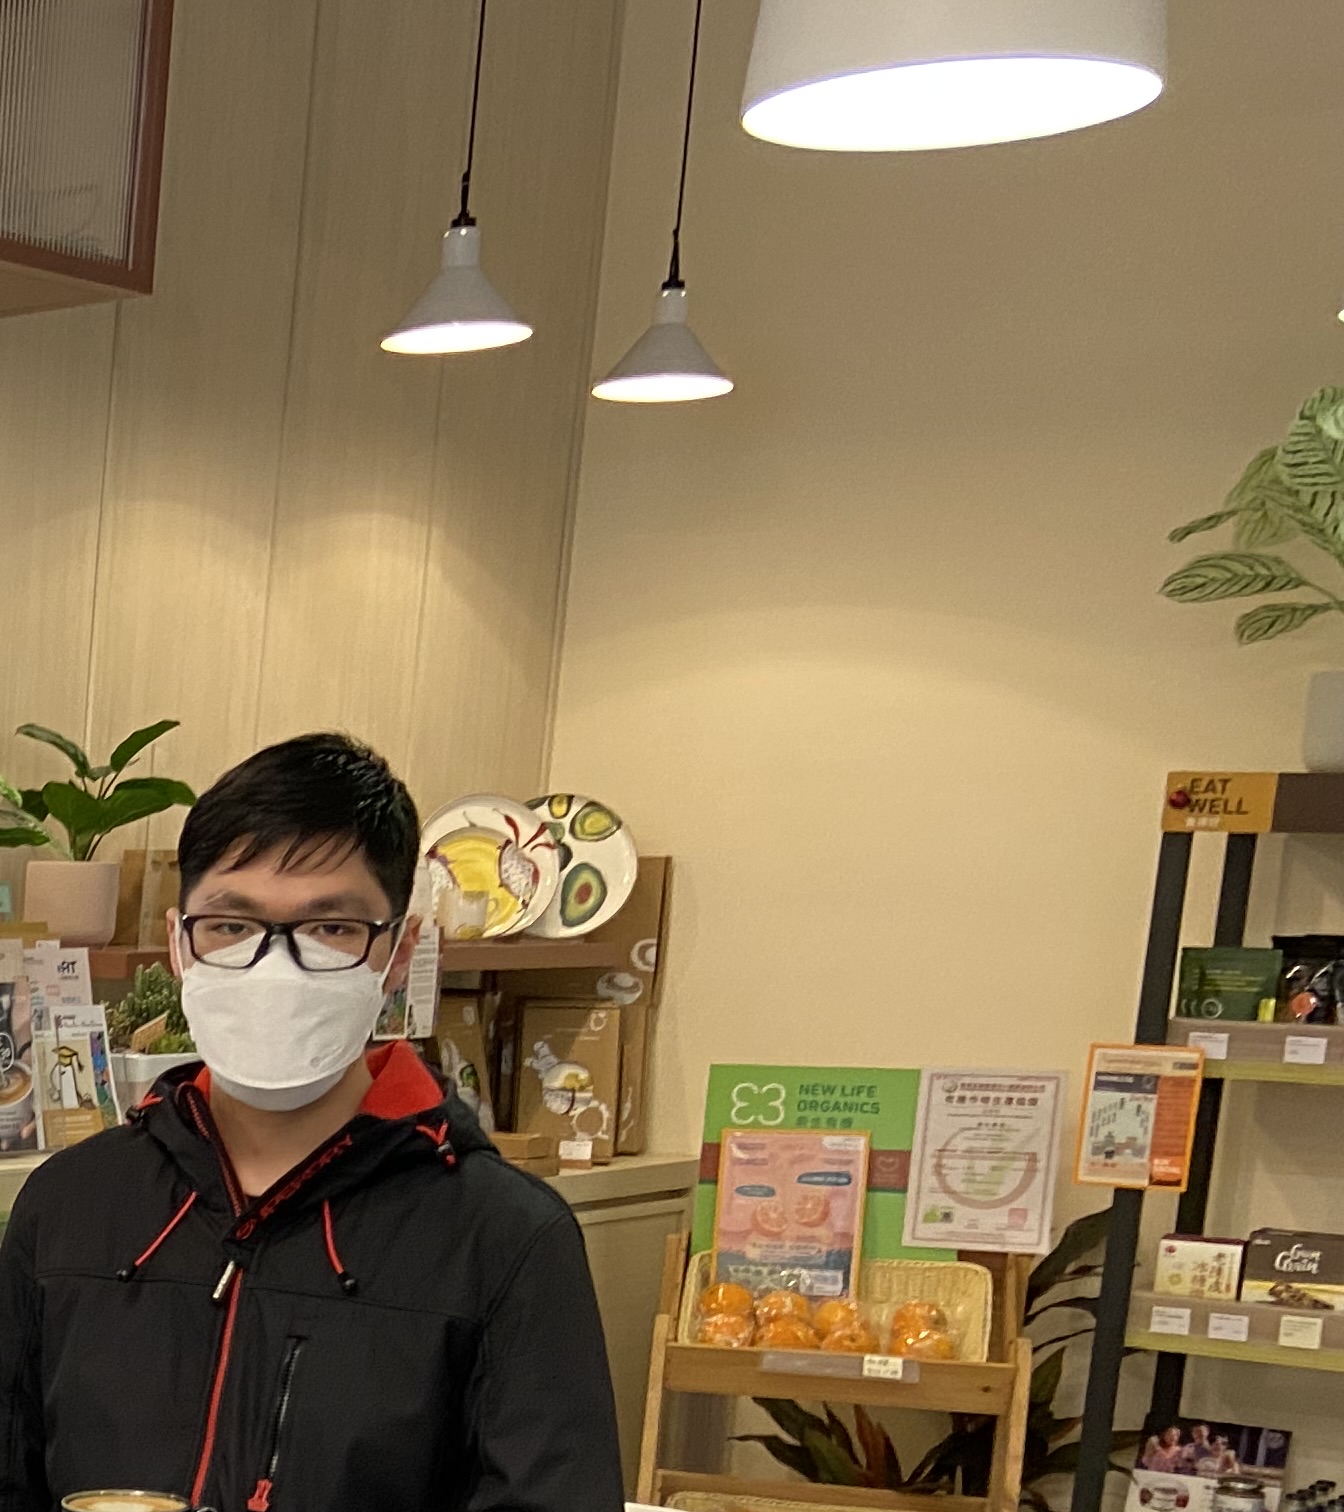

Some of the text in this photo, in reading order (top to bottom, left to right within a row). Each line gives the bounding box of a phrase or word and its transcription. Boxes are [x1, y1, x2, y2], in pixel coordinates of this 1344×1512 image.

[1190, 777, 1232, 795] EAT
[1189, 797, 1249, 815] WELL
[799, 1082, 878, 1098] NEW LIFE
[797, 1100, 880, 1114] ORGANICS
